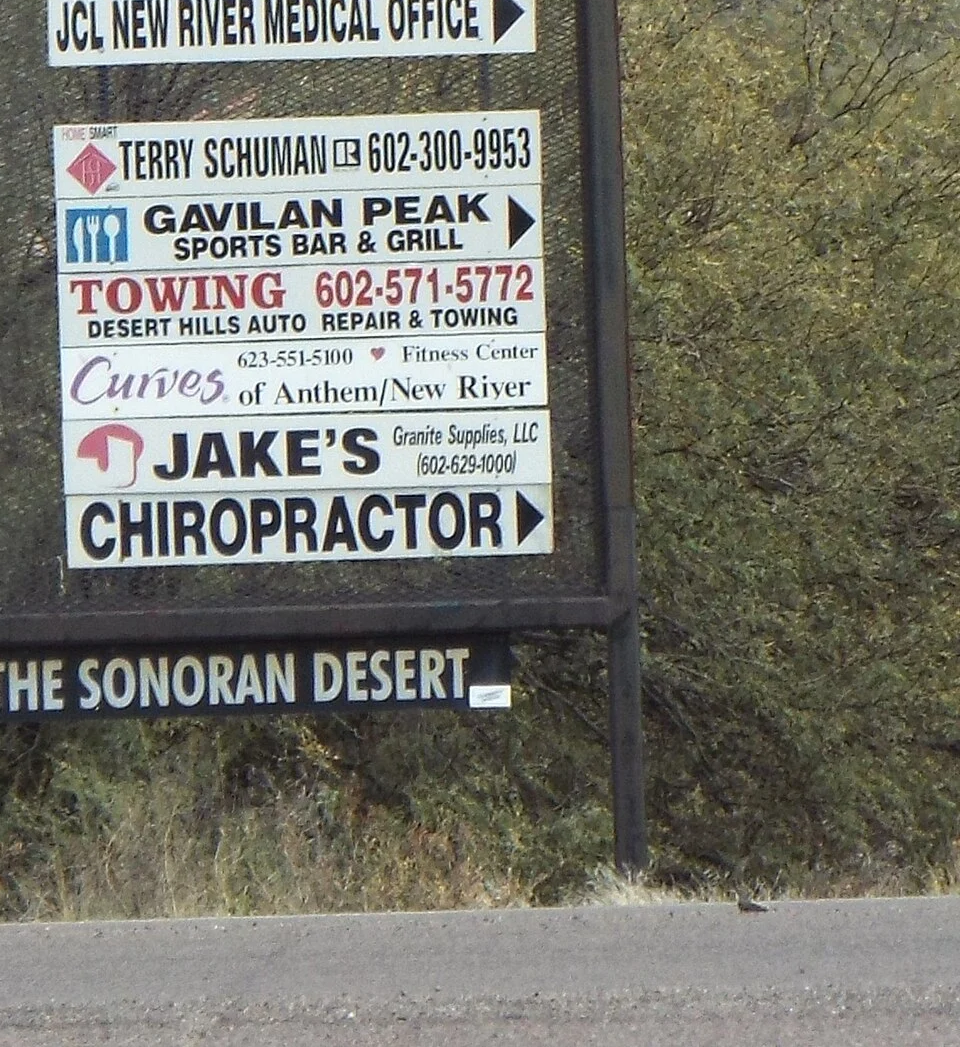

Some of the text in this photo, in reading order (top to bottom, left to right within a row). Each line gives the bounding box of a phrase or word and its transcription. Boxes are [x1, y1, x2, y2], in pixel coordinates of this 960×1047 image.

[56, 0, 103, 52] JCL
[120, 140, 193, 181] TERRY
[204, 135, 326, 177] SCHUMAN
[368, 128, 531, 173] 602-300-9953
[144, 194, 490, 233] GAVILAN PEAK
[175, 229, 463, 260] SPORTS BAR & GRILL
[70, 265, 533, 315] TOWING 602-571-5772
[88, 307, 518, 338] DESERT HILLS AUTO REPAIR & TOWING
[238, 344, 539, 368] 623-551-5100 Fitness Center
[70, 356, 225, 406] Curves
[240, 376, 531, 407] of Anthem/New River
[154, 428, 380, 481] JAKE'S
[393, 423, 539, 449] Granite Supplies, LLC
[417, 451, 516, 476] (602-629-1000)
[80, 492, 501, 560] CHIROPRACTOR
[78, 655, 295, 710] SONORAN
[312, 648, 469, 701] DESERT
